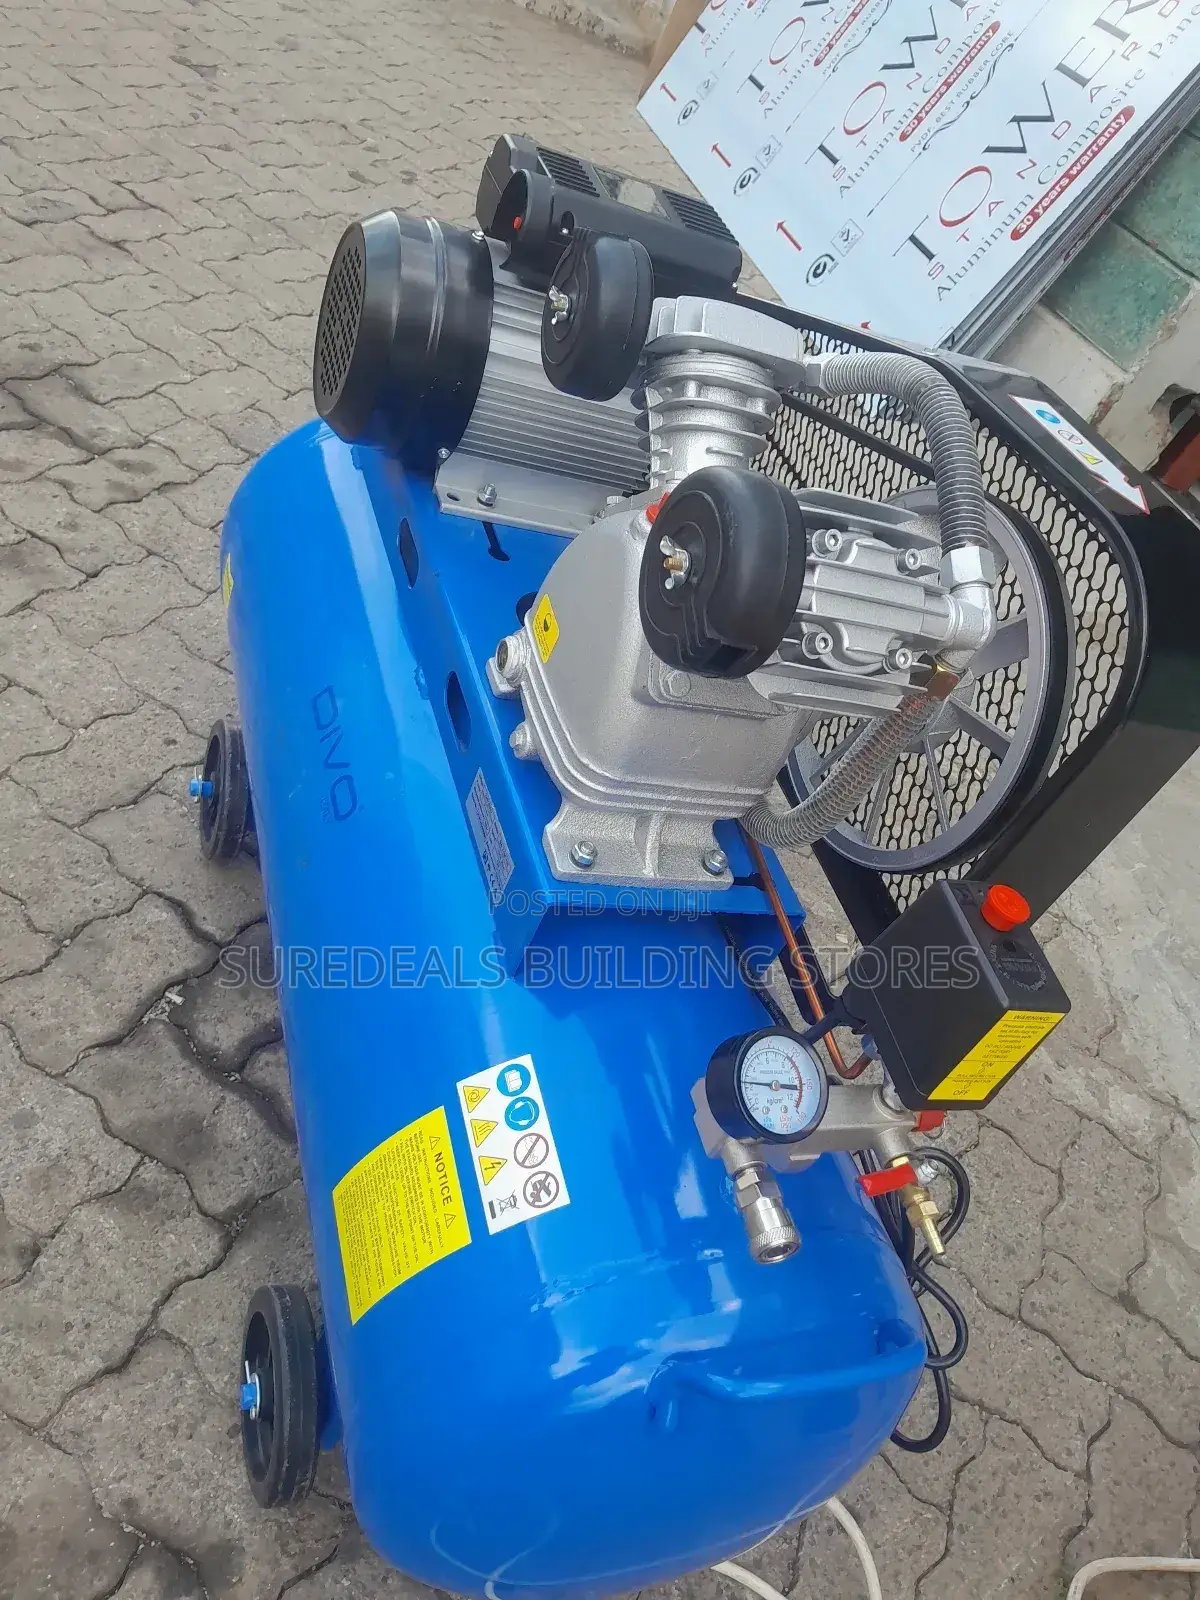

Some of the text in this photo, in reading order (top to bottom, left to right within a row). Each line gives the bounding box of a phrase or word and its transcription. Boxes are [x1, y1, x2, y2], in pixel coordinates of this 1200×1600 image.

[892, 0, 1160, 264] TOWER
[903, 28, 994, 137] 30 years warranty
[935, 99, 955, 123] BEST
[956, 58, 988, 99] RUBBER
[988, 30, 1015, 57] CORE
[839, 101, 920, 198] Aluminum
[927, 0, 1181, 280] STANDARD
[936, 193, 1034, 301] Aluminum
[1037, 68, 1146, 185] Composite
[1017, 114, 1127, 234] 30 years warranty
[311, 685, 359, 821] DIVO
[433, 1151, 453, 1207] NOTICE
